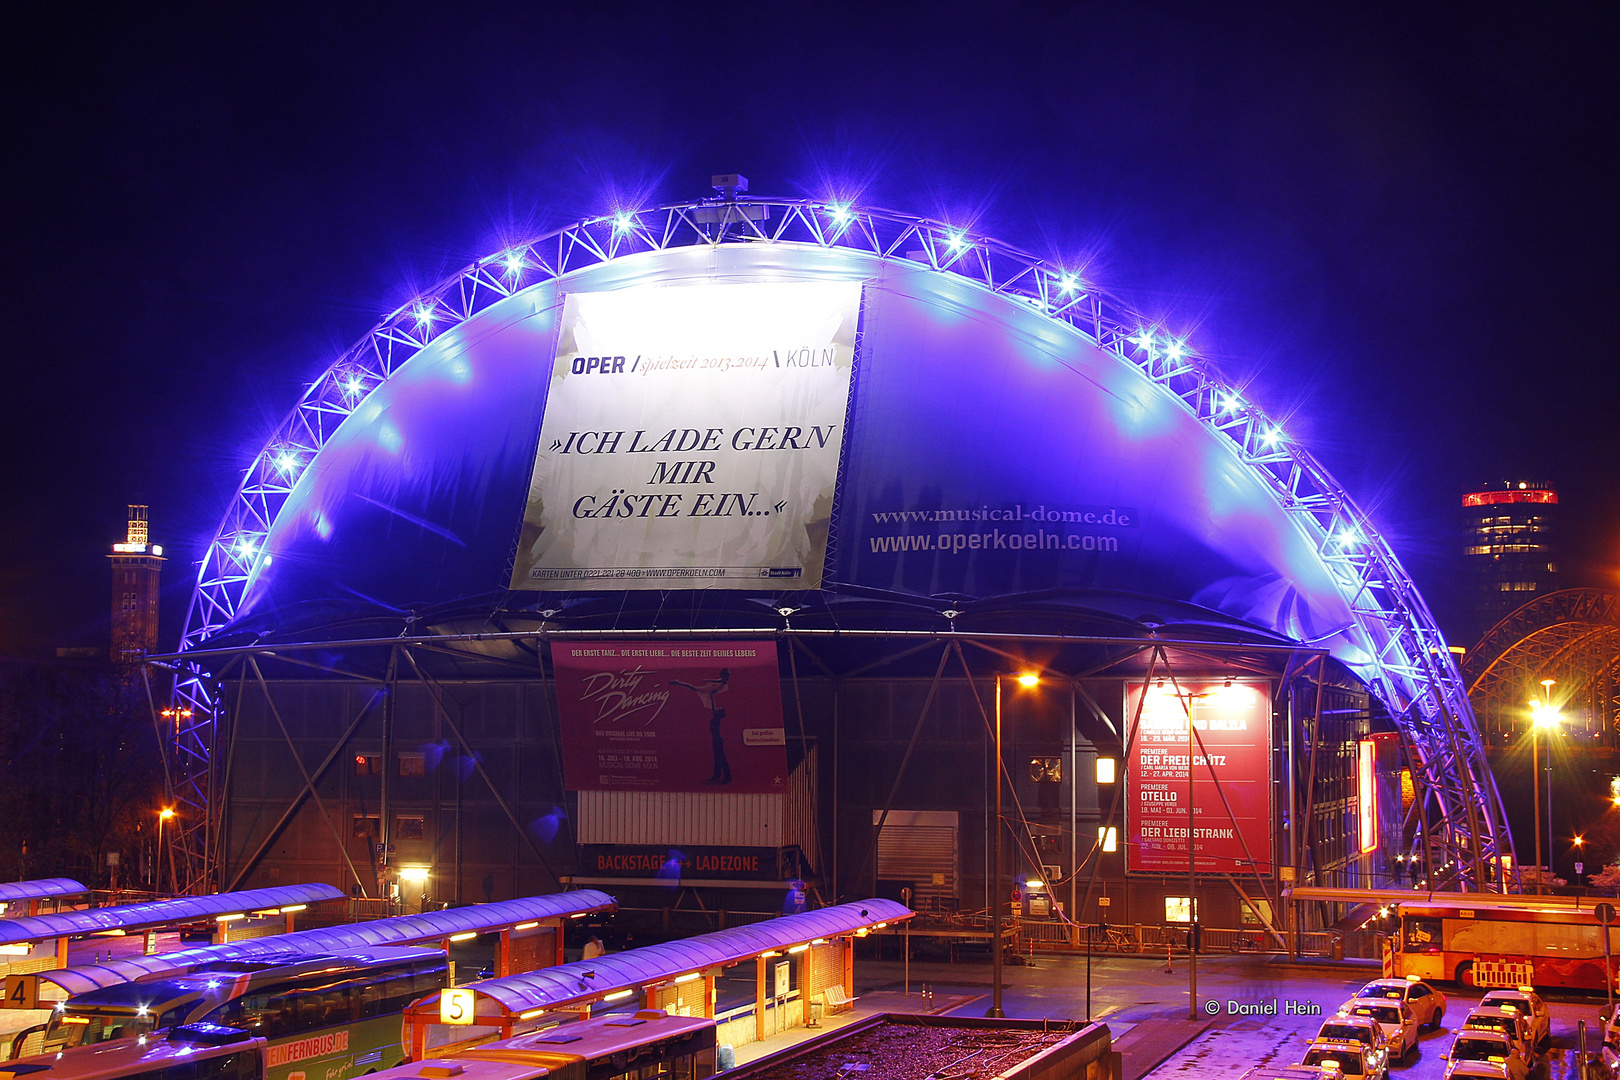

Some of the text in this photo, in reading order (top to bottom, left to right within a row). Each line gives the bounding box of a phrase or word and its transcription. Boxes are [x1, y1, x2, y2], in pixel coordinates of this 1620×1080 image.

[571, 356, 626, 375] OPER
[699, 354, 770, 373] 2013.2014
[786, 345, 835, 369] KÖLN
[548, 425, 837, 455] »ICH LADE GERN
[647, 460, 717, 485] MIR
[571, 488, 684, 519] GÄSTE
[871, 505, 1131, 526] www.musical-dome.de
[869, 529, 1119, 554] www.operkoeln.com
[531, 569, 558, 579] KARTEN
[560, 569, 583, 578] UNTER
[571, 649, 583, 657] DER
[583, 649, 600, 657] ERSTE
[600, 649, 621, 657] TANZ...
[621, 649, 631, 657] DIE
[631, 649, 649, 657] ERSTE
[713, 650, 734, 658] DEINES
[734, 650, 757, 658] LEBENS
[579, 664, 657, 701] Dirty
[593, 684, 671, 726] Dancing
[1140, 755, 1160, 766] DER
[1140, 791, 1177, 801] OTELLO
[1141, 827, 1161, 838] DER
[597, 855, 666, 870] BACKSTAGE
[696, 855, 759, 871] LADEZONE
[10, 980, 26, 1005] 4
[450, 994, 463, 1020] 5
[267, 1030, 349, 1068] EINFERNBUS.DE
